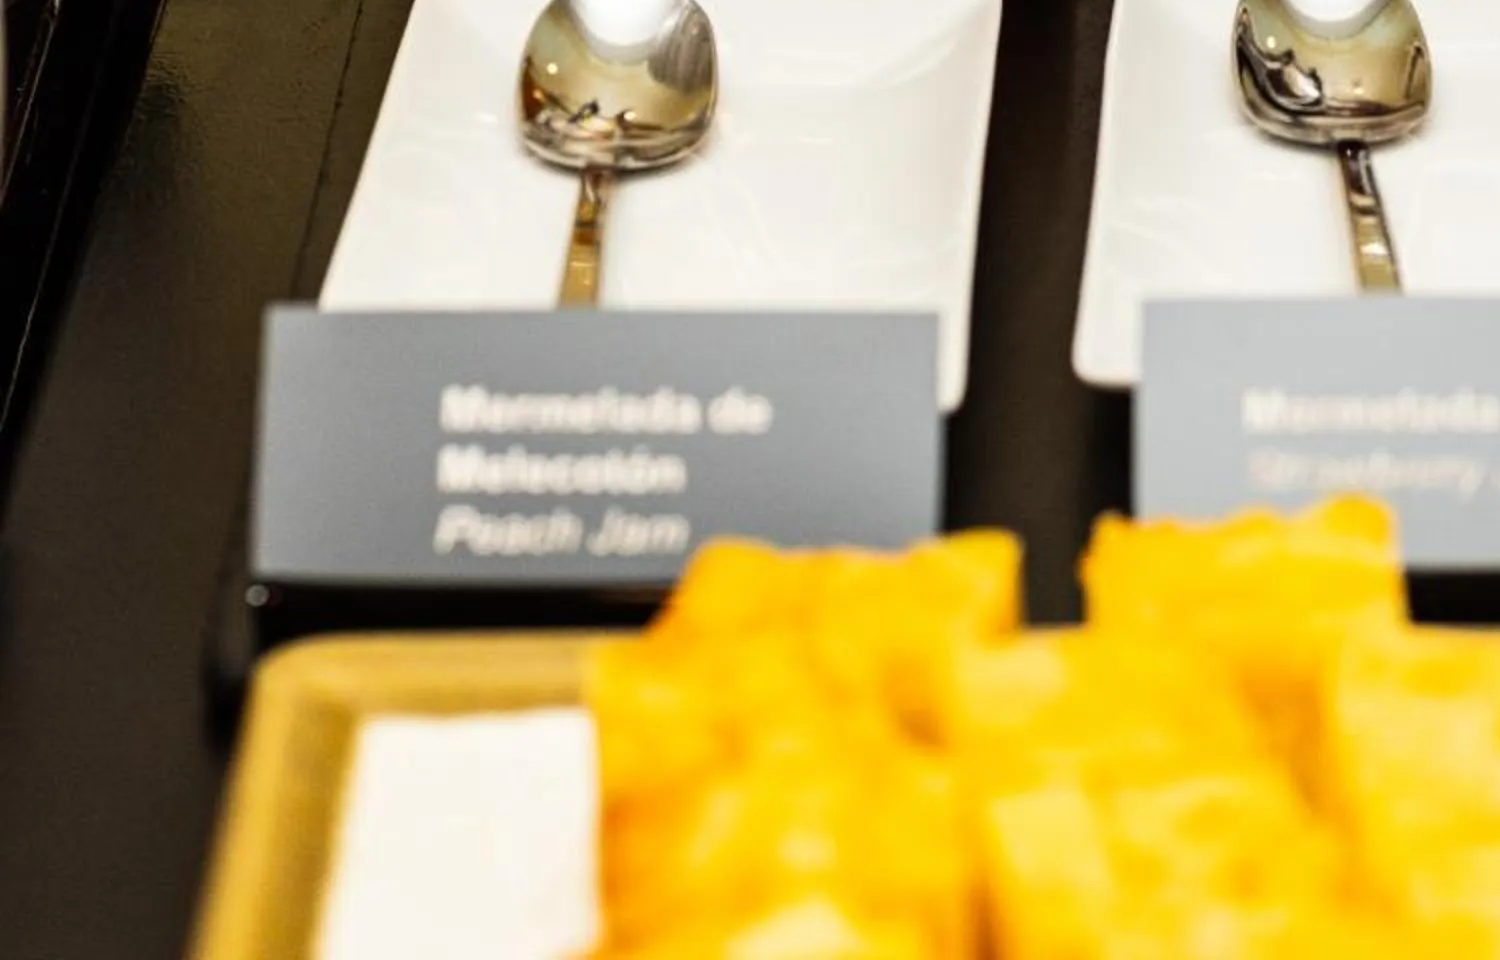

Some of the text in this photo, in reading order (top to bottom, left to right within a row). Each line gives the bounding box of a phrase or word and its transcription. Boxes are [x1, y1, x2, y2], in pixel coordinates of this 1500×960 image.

[440, 384, 772, 433] Mermelada de
[435, 505, 690, 555] Peach Jam
